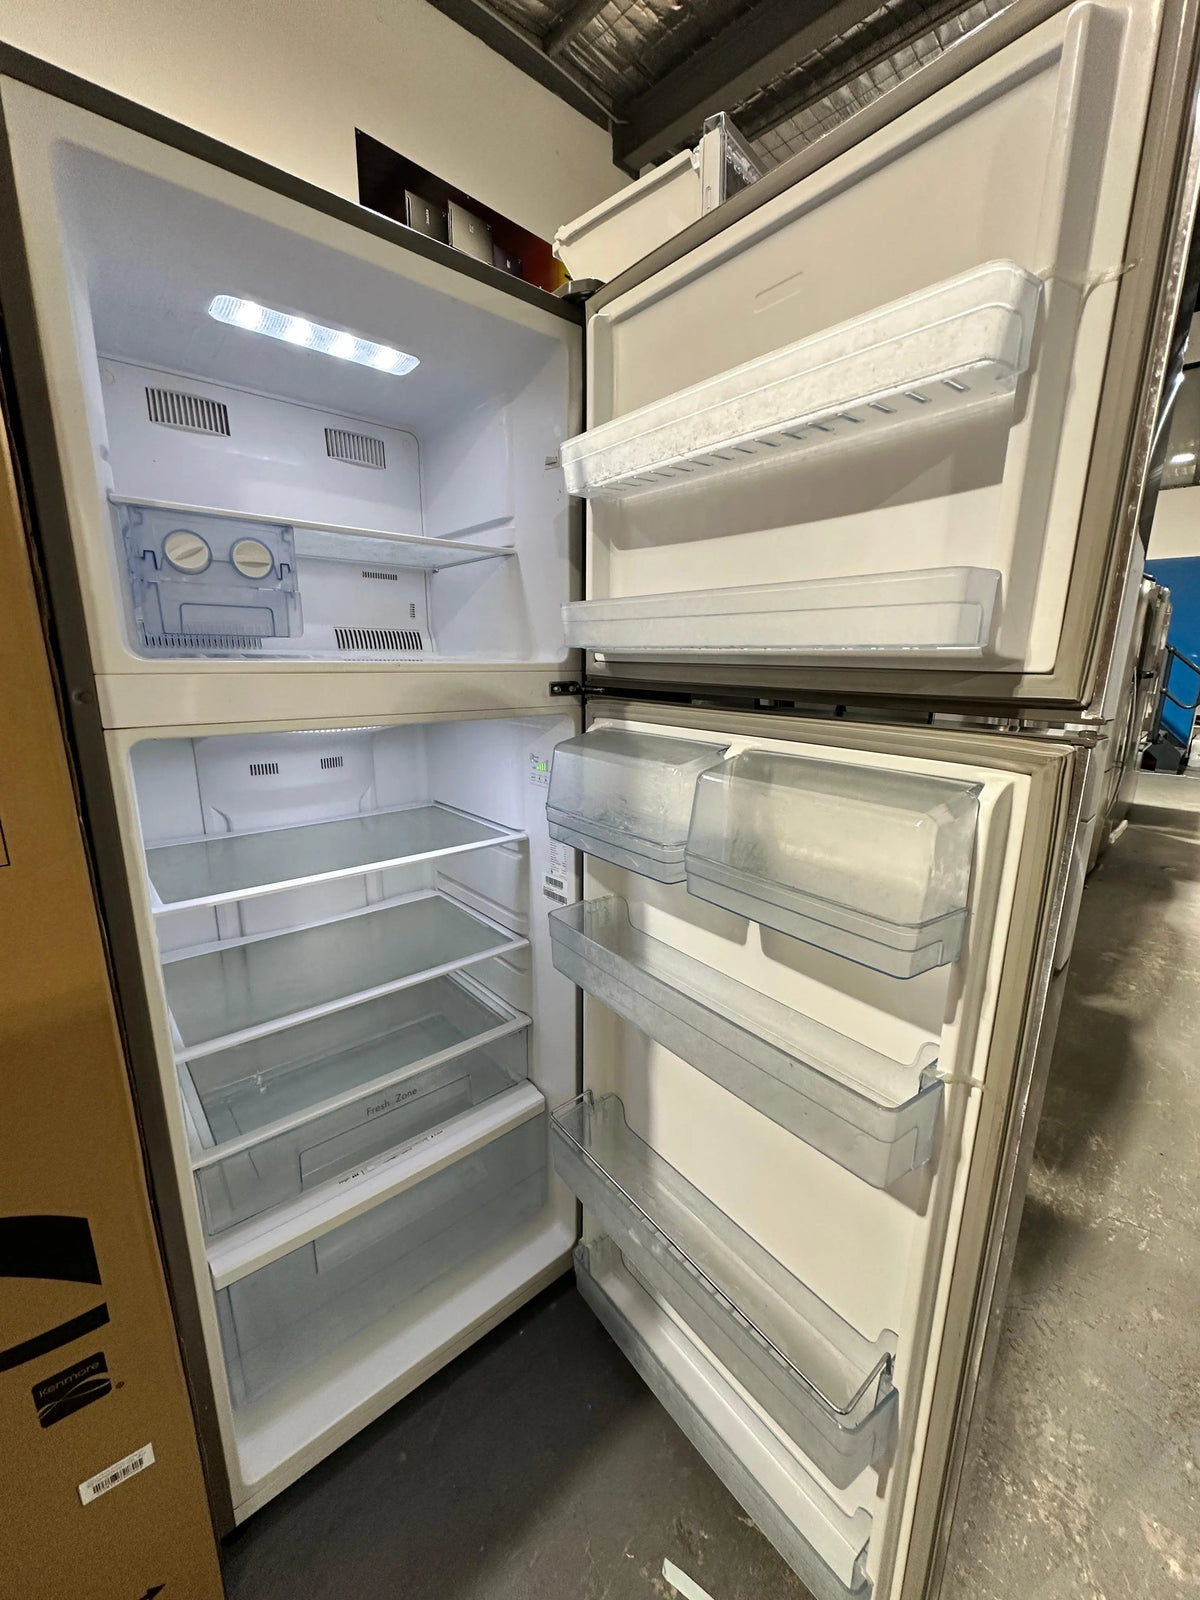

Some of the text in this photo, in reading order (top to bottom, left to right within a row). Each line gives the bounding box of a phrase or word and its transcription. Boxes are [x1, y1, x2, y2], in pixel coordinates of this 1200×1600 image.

[366, 1088, 418, 1116] Fresh Zone
[38, 1361, 100, 1398] Kenmore
